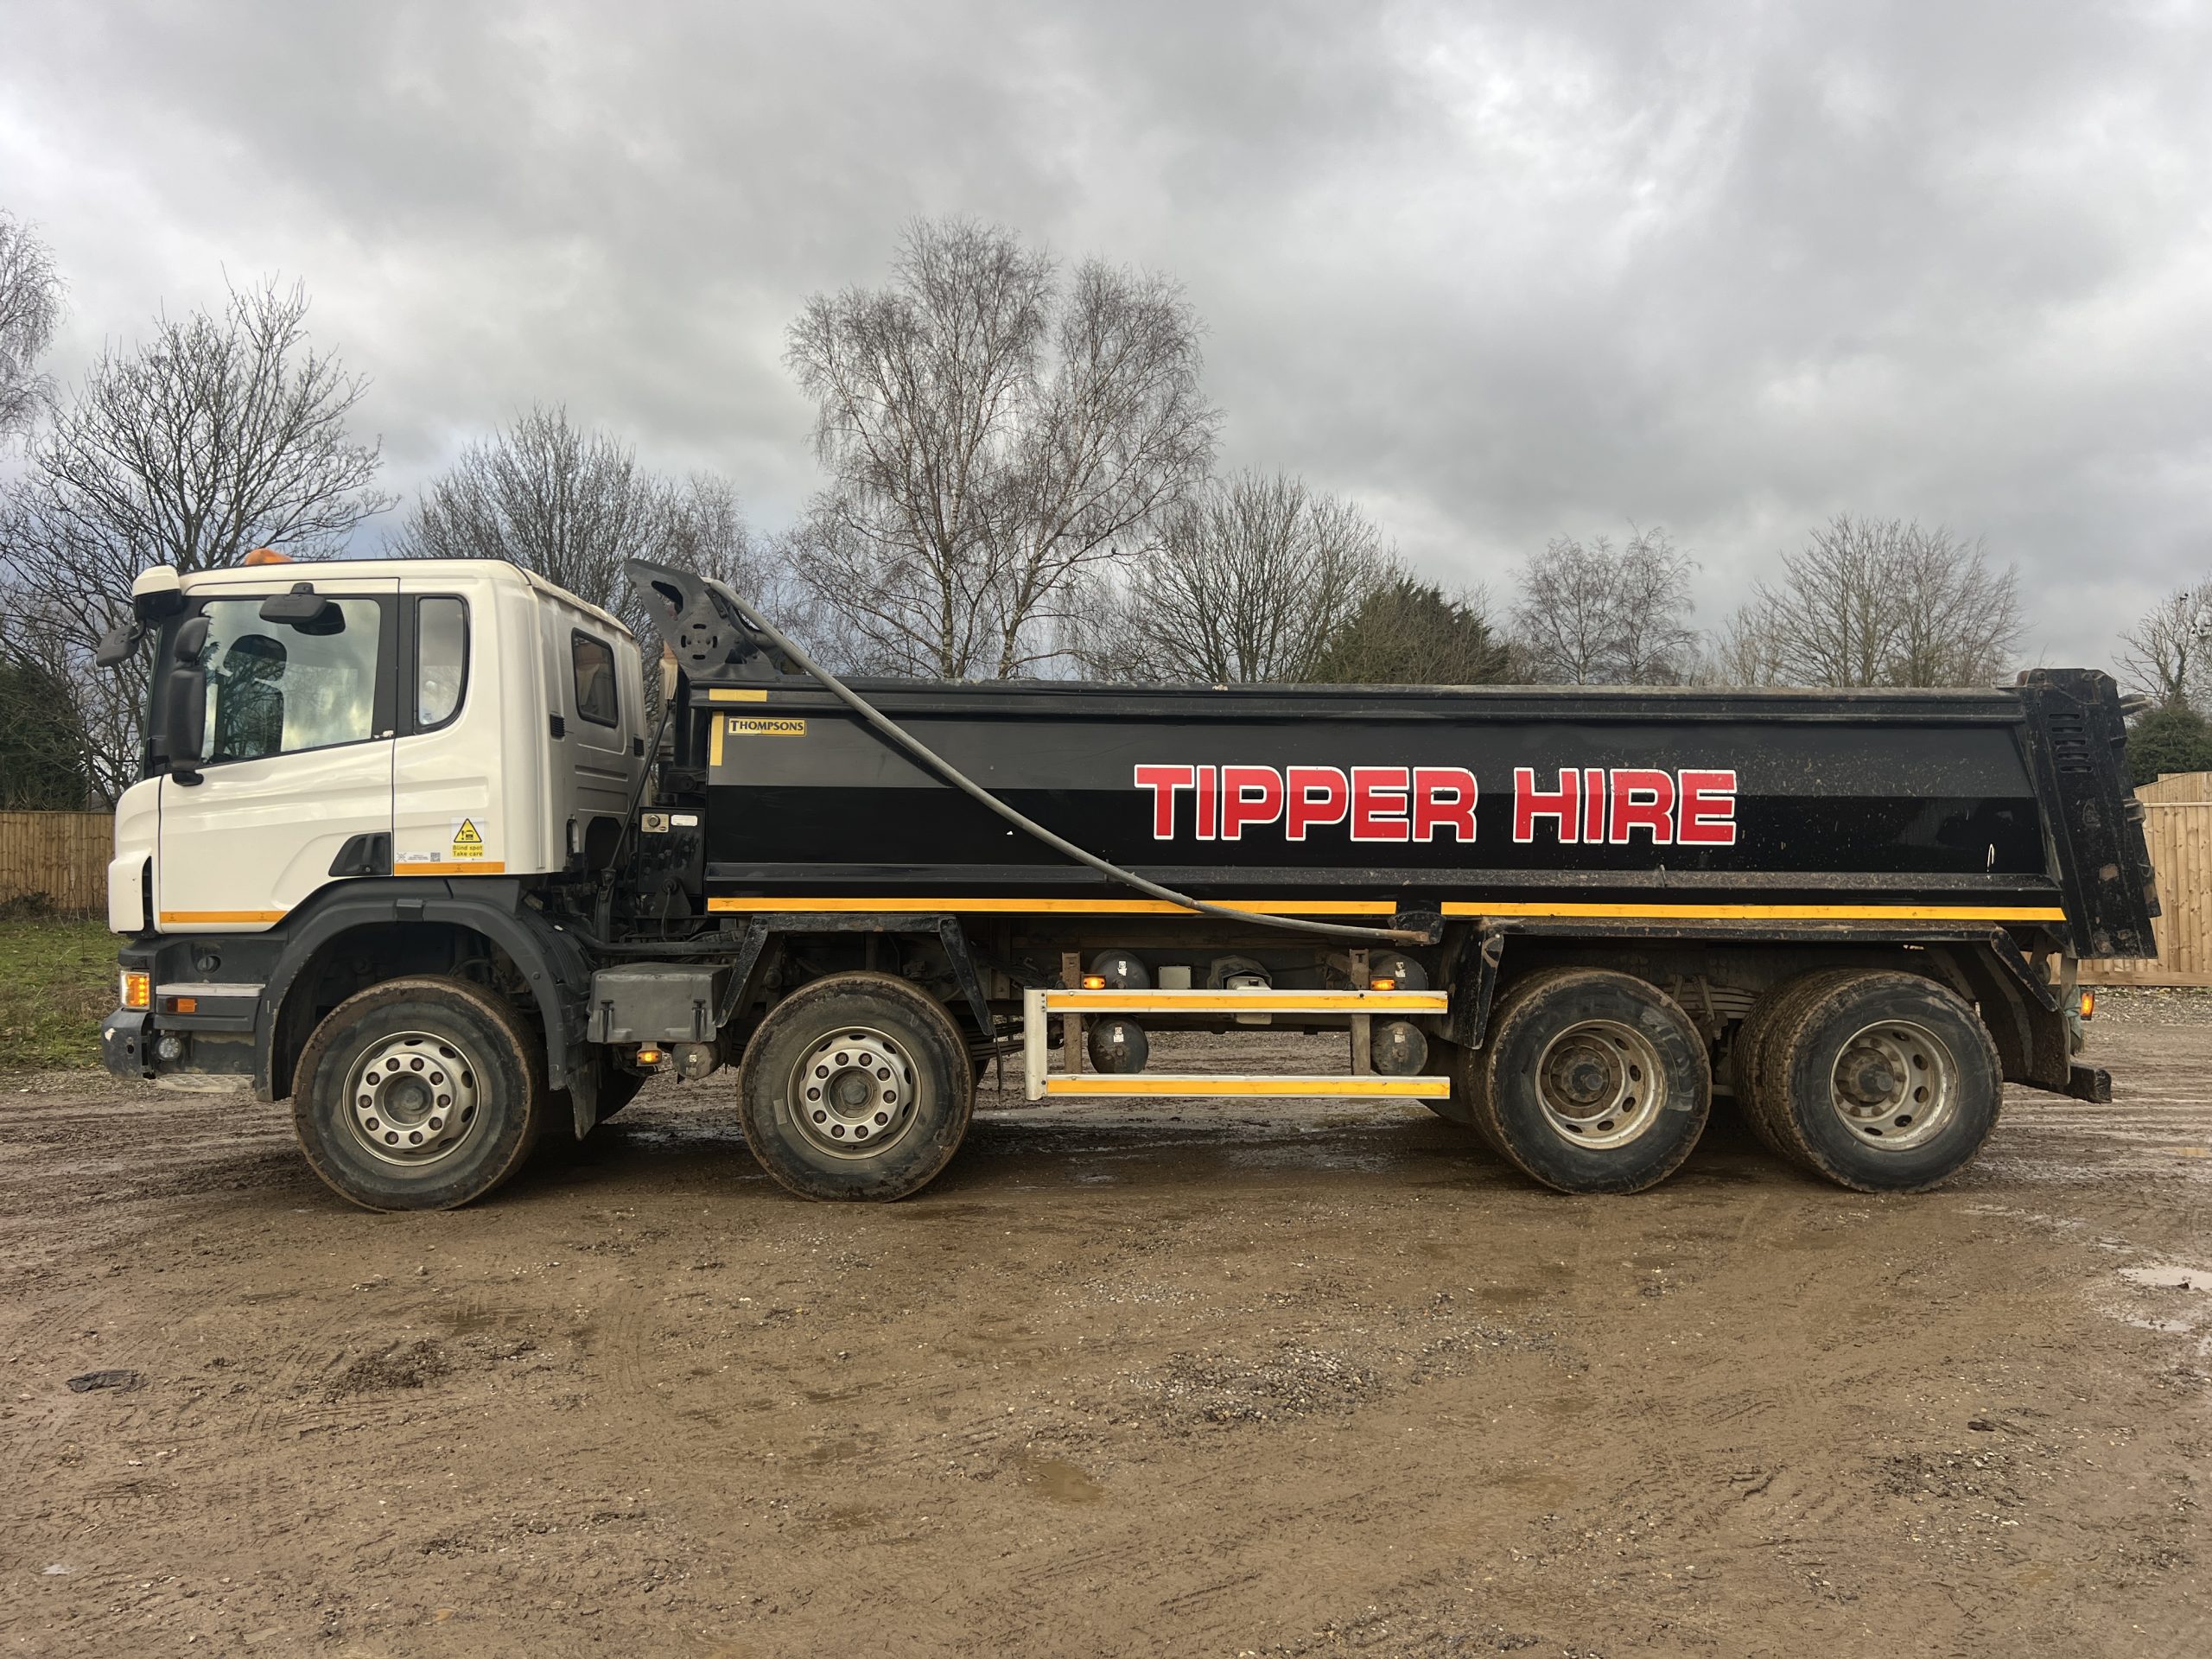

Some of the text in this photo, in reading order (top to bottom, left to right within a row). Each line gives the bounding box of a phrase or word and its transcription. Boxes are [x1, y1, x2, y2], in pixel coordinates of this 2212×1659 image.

[730, 720, 804, 731] THOMPSONS
[1134, 764, 1738, 846] TIPPER HIRE
